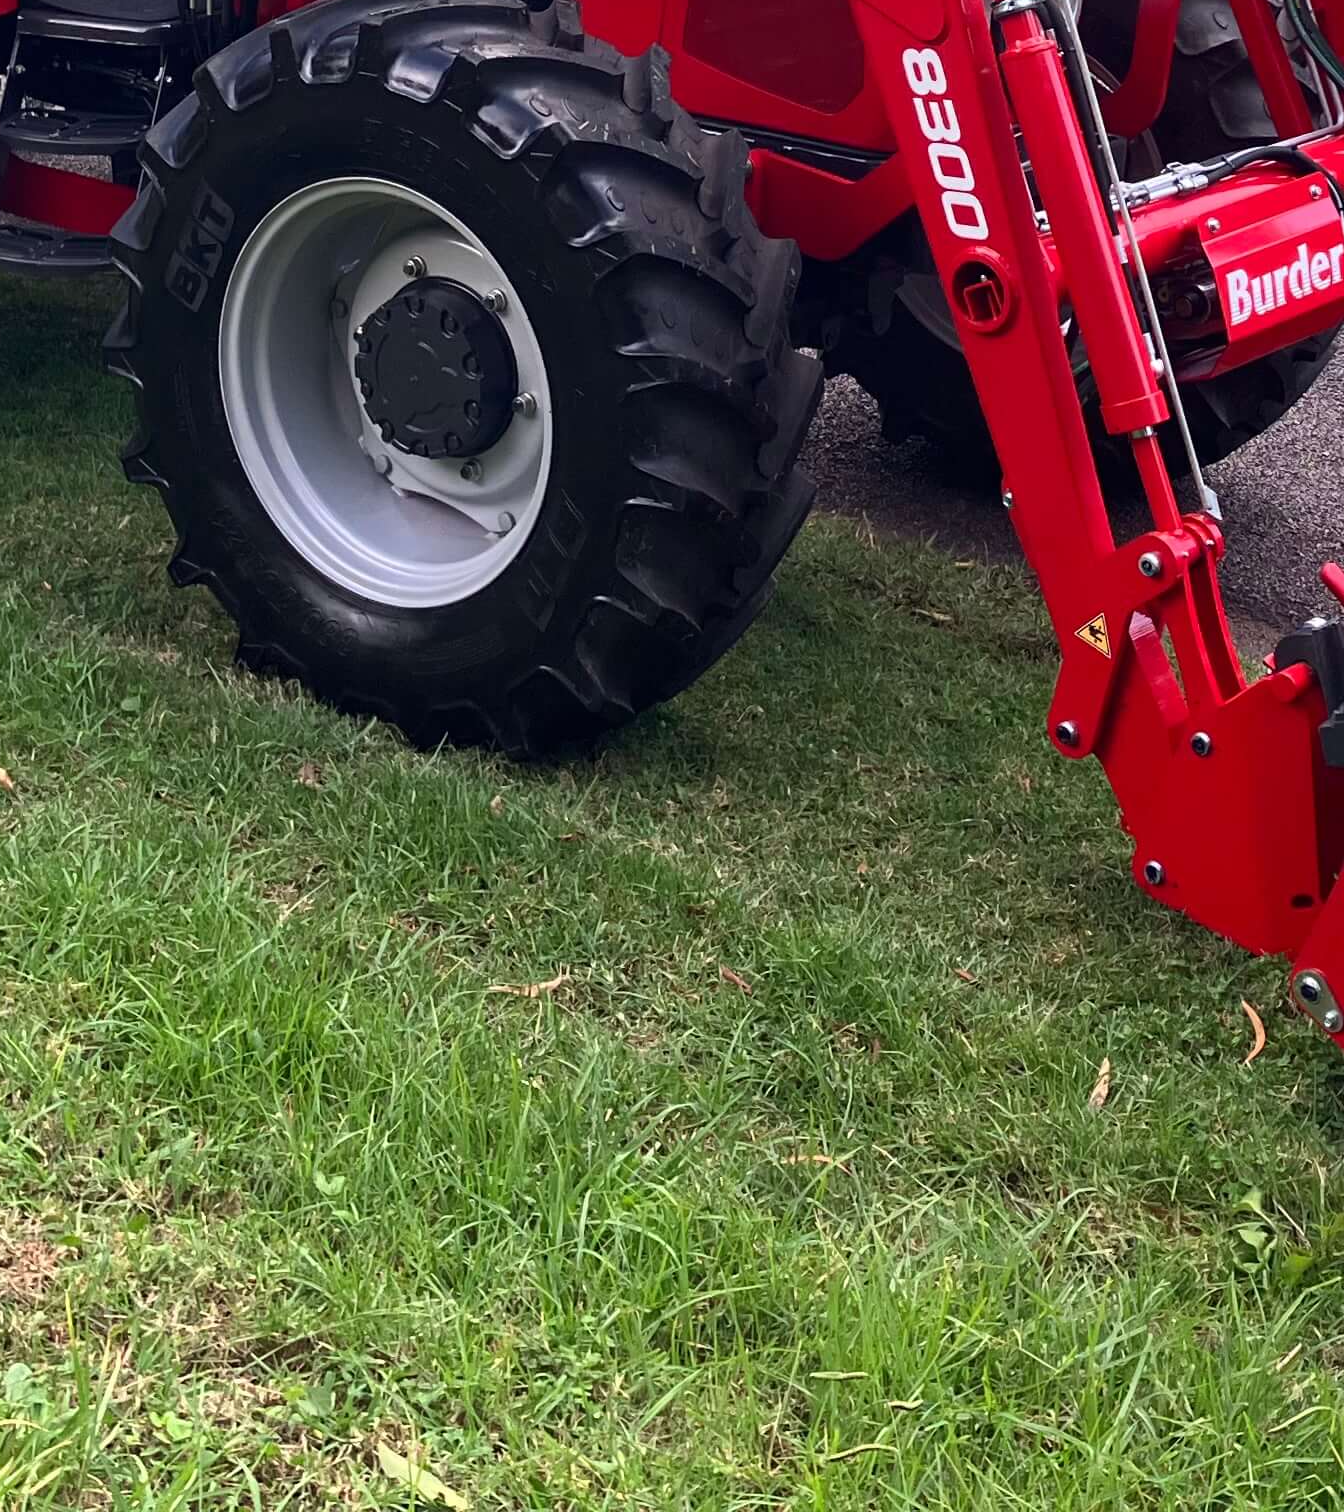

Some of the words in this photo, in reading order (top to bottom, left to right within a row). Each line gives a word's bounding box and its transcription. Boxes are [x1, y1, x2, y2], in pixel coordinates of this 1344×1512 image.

[902, 48, 989, 240] 8300
[167, 185, 233, 310] BKT
[1225, 242, 1344, 326] Burder
